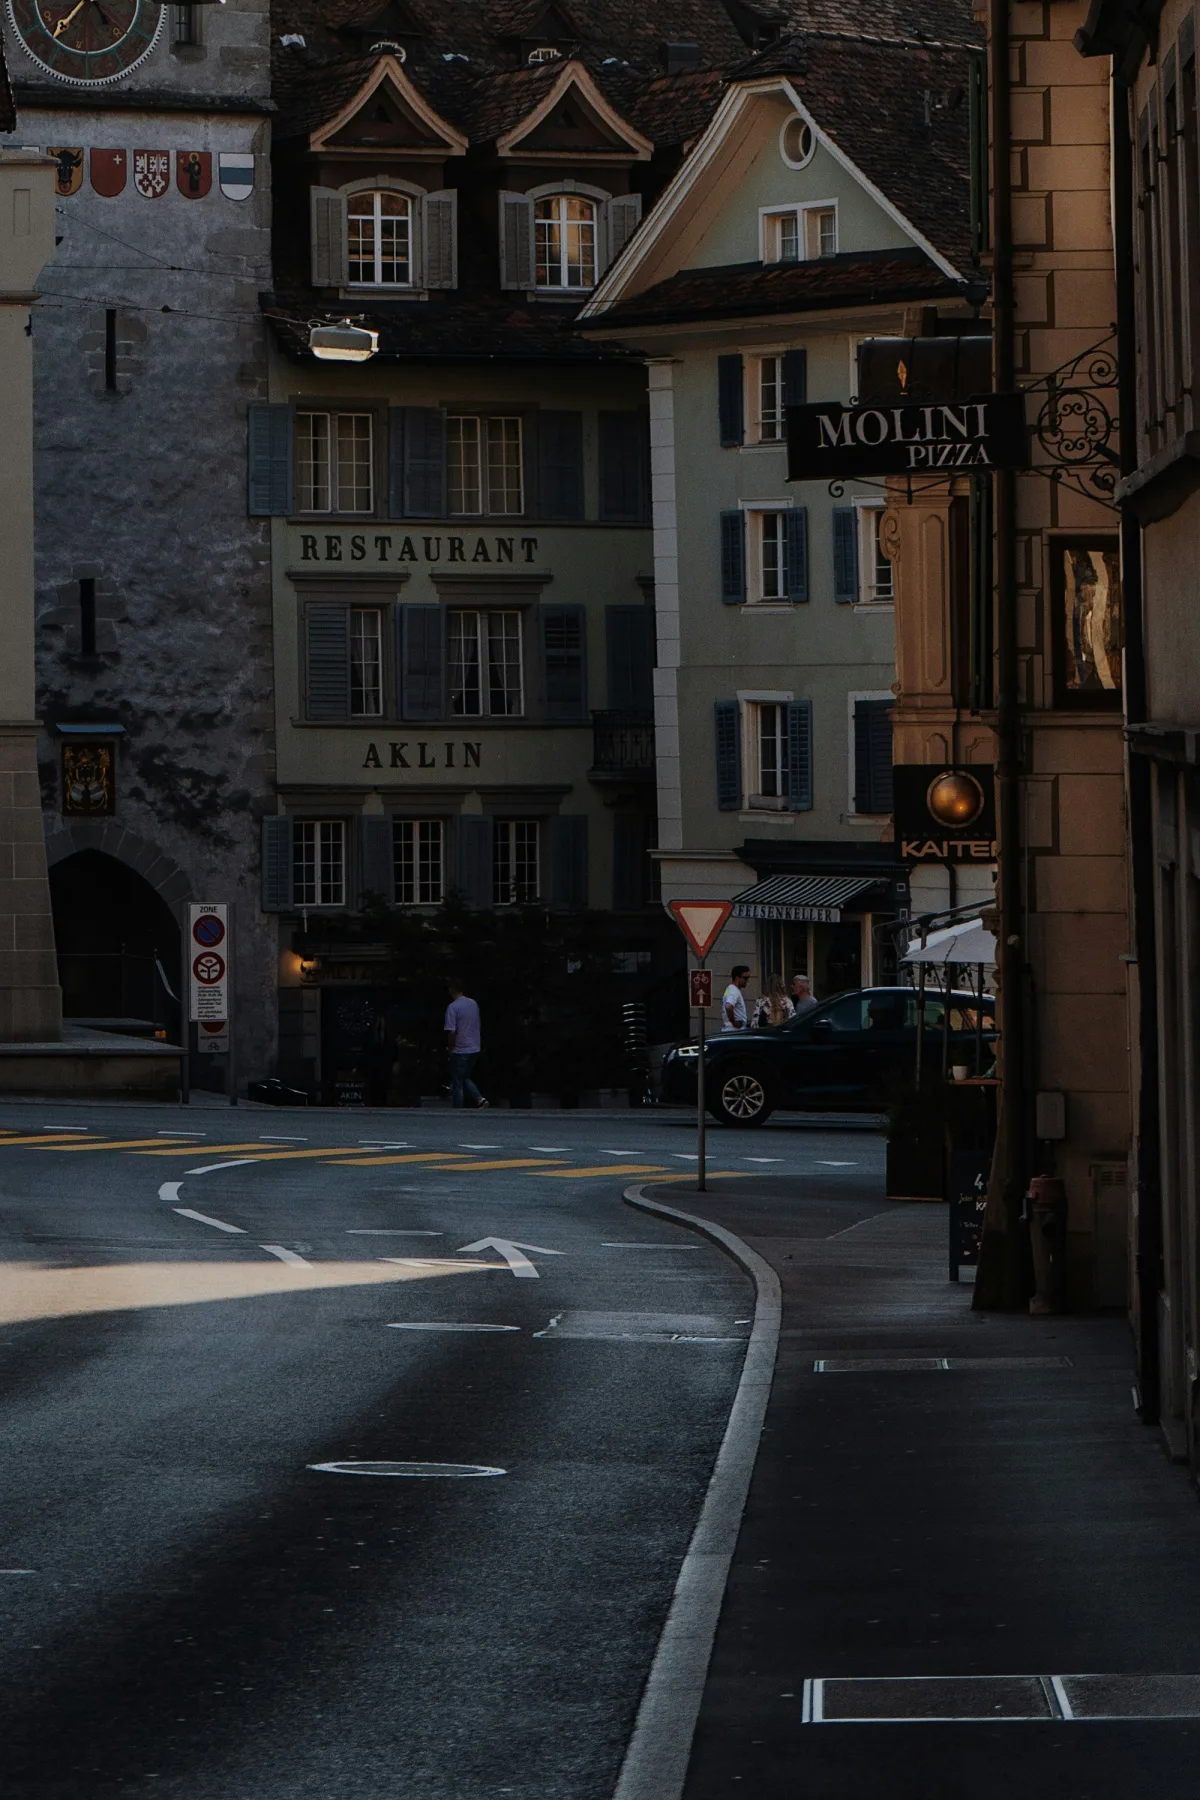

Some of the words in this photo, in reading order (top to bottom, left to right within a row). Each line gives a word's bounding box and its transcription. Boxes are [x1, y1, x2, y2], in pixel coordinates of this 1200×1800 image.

[815, 403, 991, 448] MOLINI
[905, 443, 993, 468] PIZZA
[300, 535, 538, 562] RESTAURANT
[362, 742, 482, 768] AKLIN
